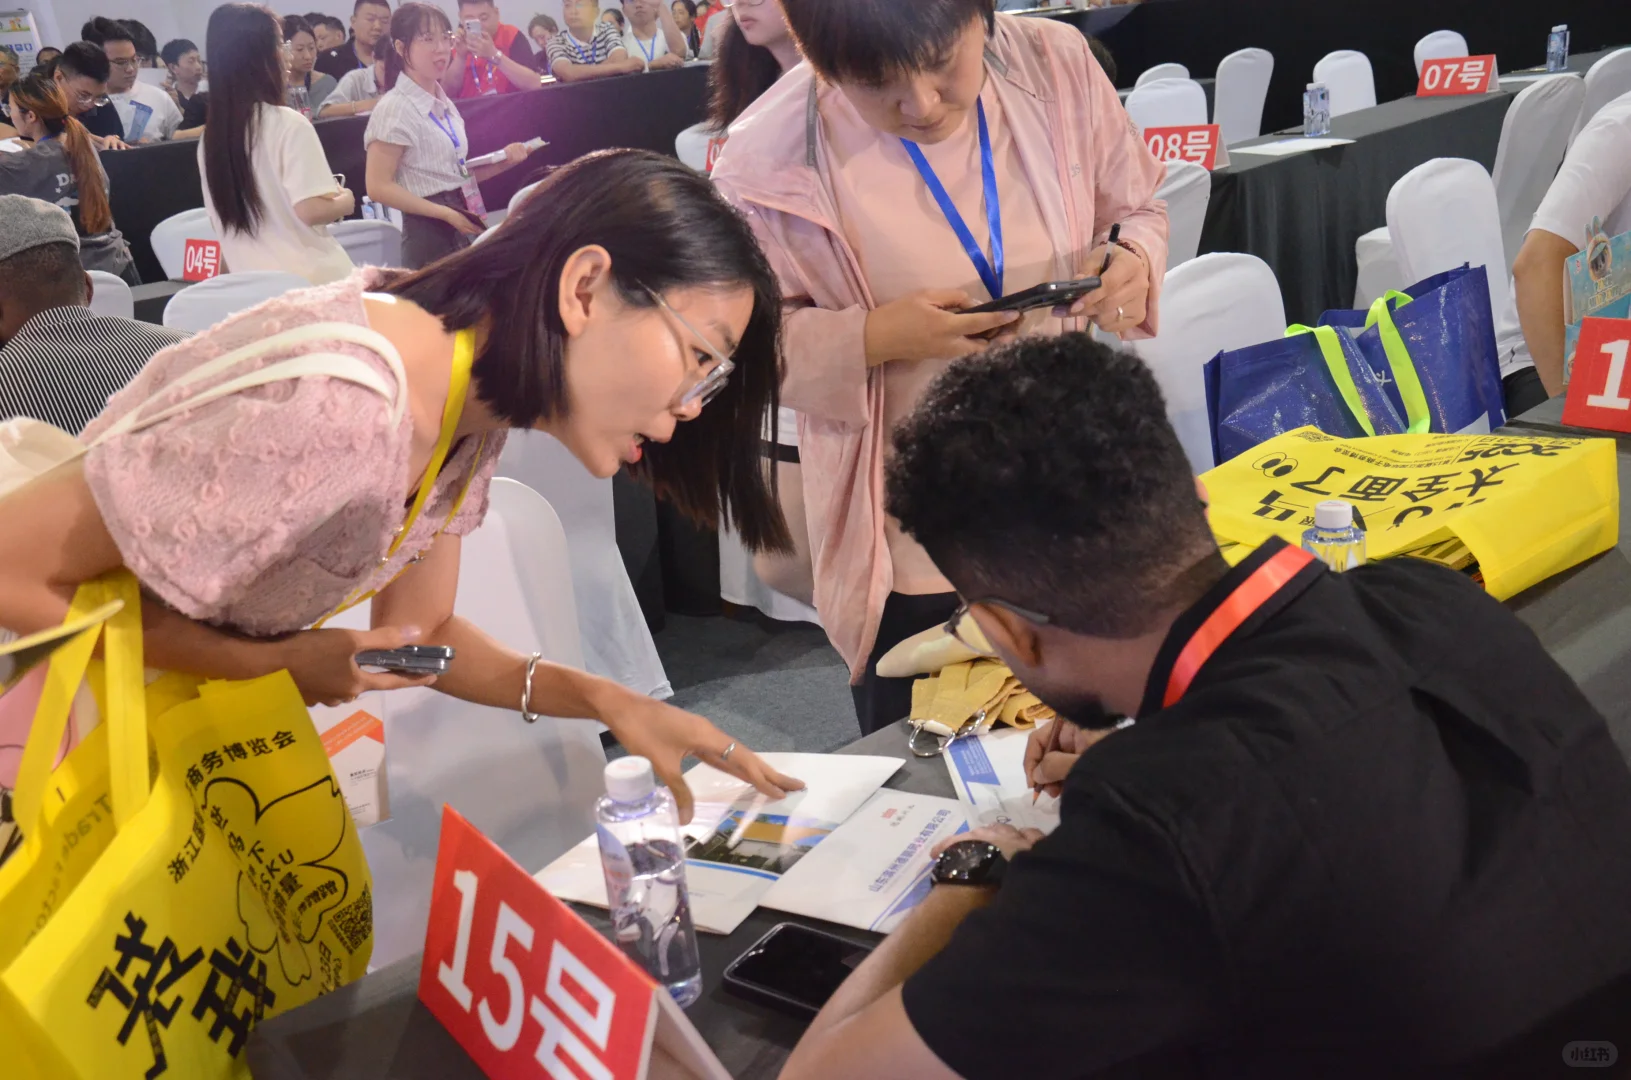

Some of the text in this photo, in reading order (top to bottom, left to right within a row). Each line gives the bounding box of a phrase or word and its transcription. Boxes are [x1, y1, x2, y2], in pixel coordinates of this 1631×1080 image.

[1424, 61, 1486, 92] 07号
[1148, 131, 1212, 164] 08号
[186, 245, 217, 277] 04号
[438, 870, 616, 1080] 15号
